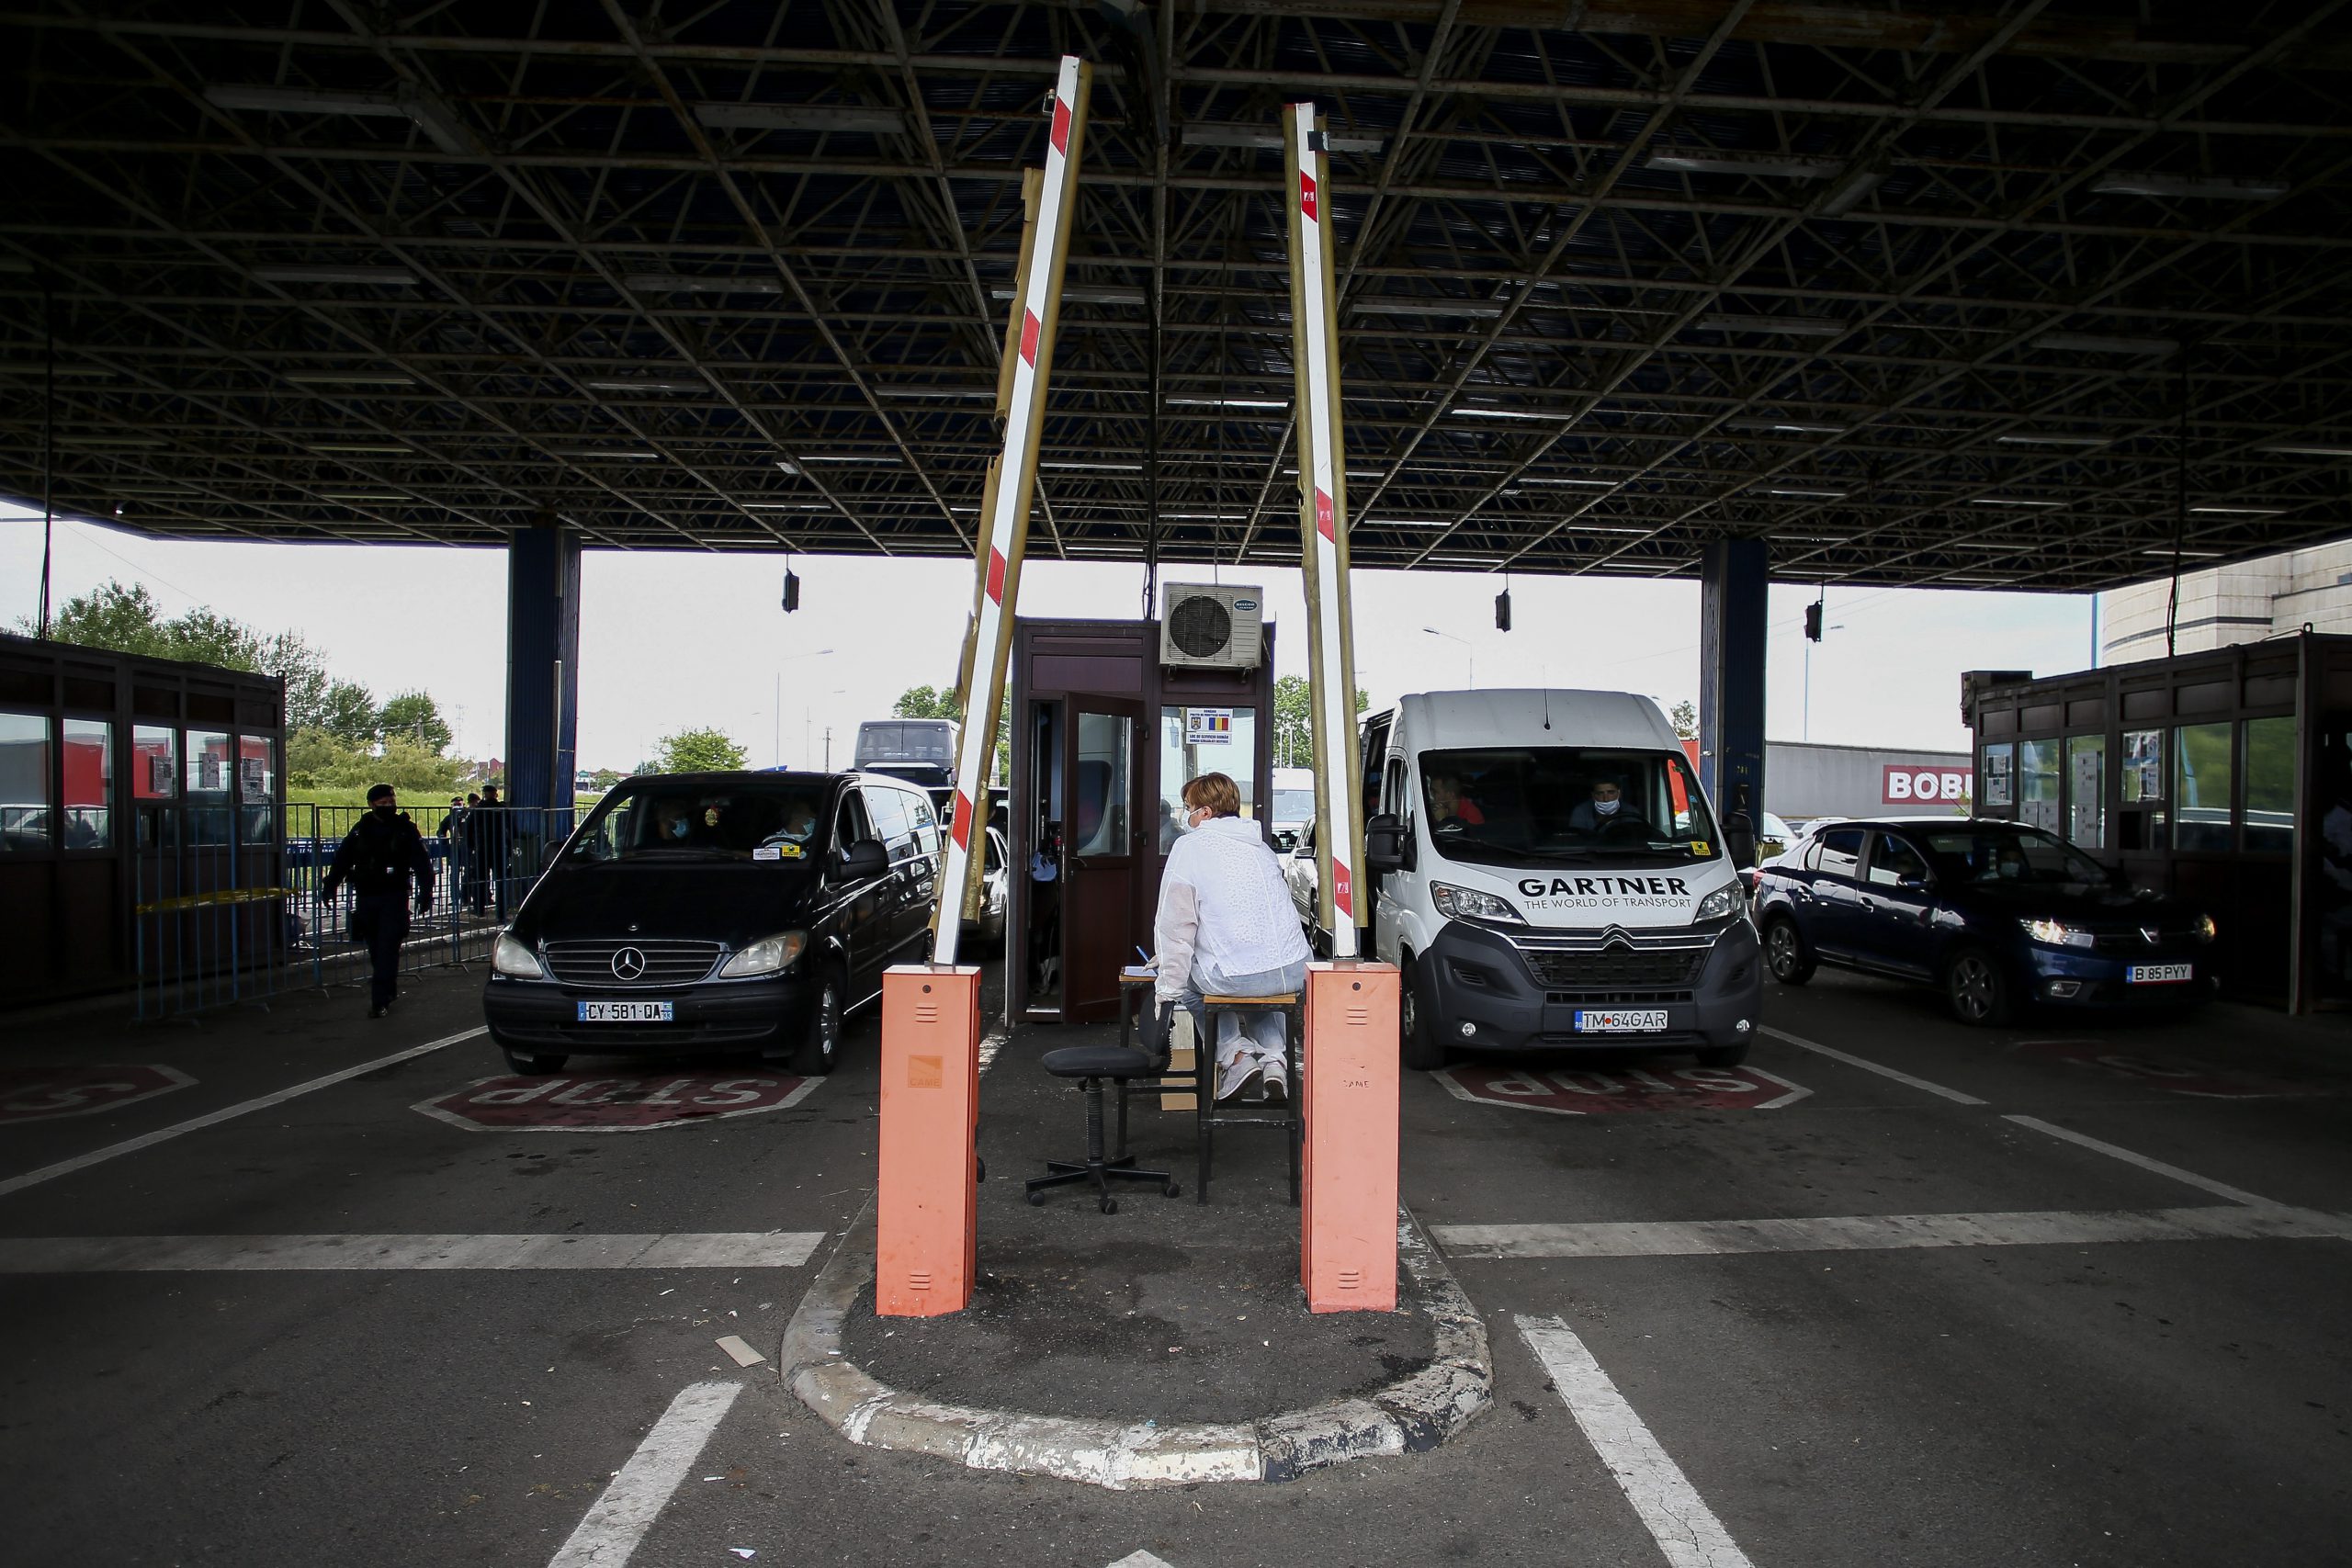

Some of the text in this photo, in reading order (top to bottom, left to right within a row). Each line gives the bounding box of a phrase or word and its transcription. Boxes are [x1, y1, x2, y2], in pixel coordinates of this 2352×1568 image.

[1518, 877, 1691, 897] GARTNER
[1524, 897, 1691, 909] THE WORLD OF TRANSPORT
[2135, 965, 2188, 980] B 85 PYY
[662, 1011, 673, 1020] 33
[469, 1078, 779, 1105] STOP
